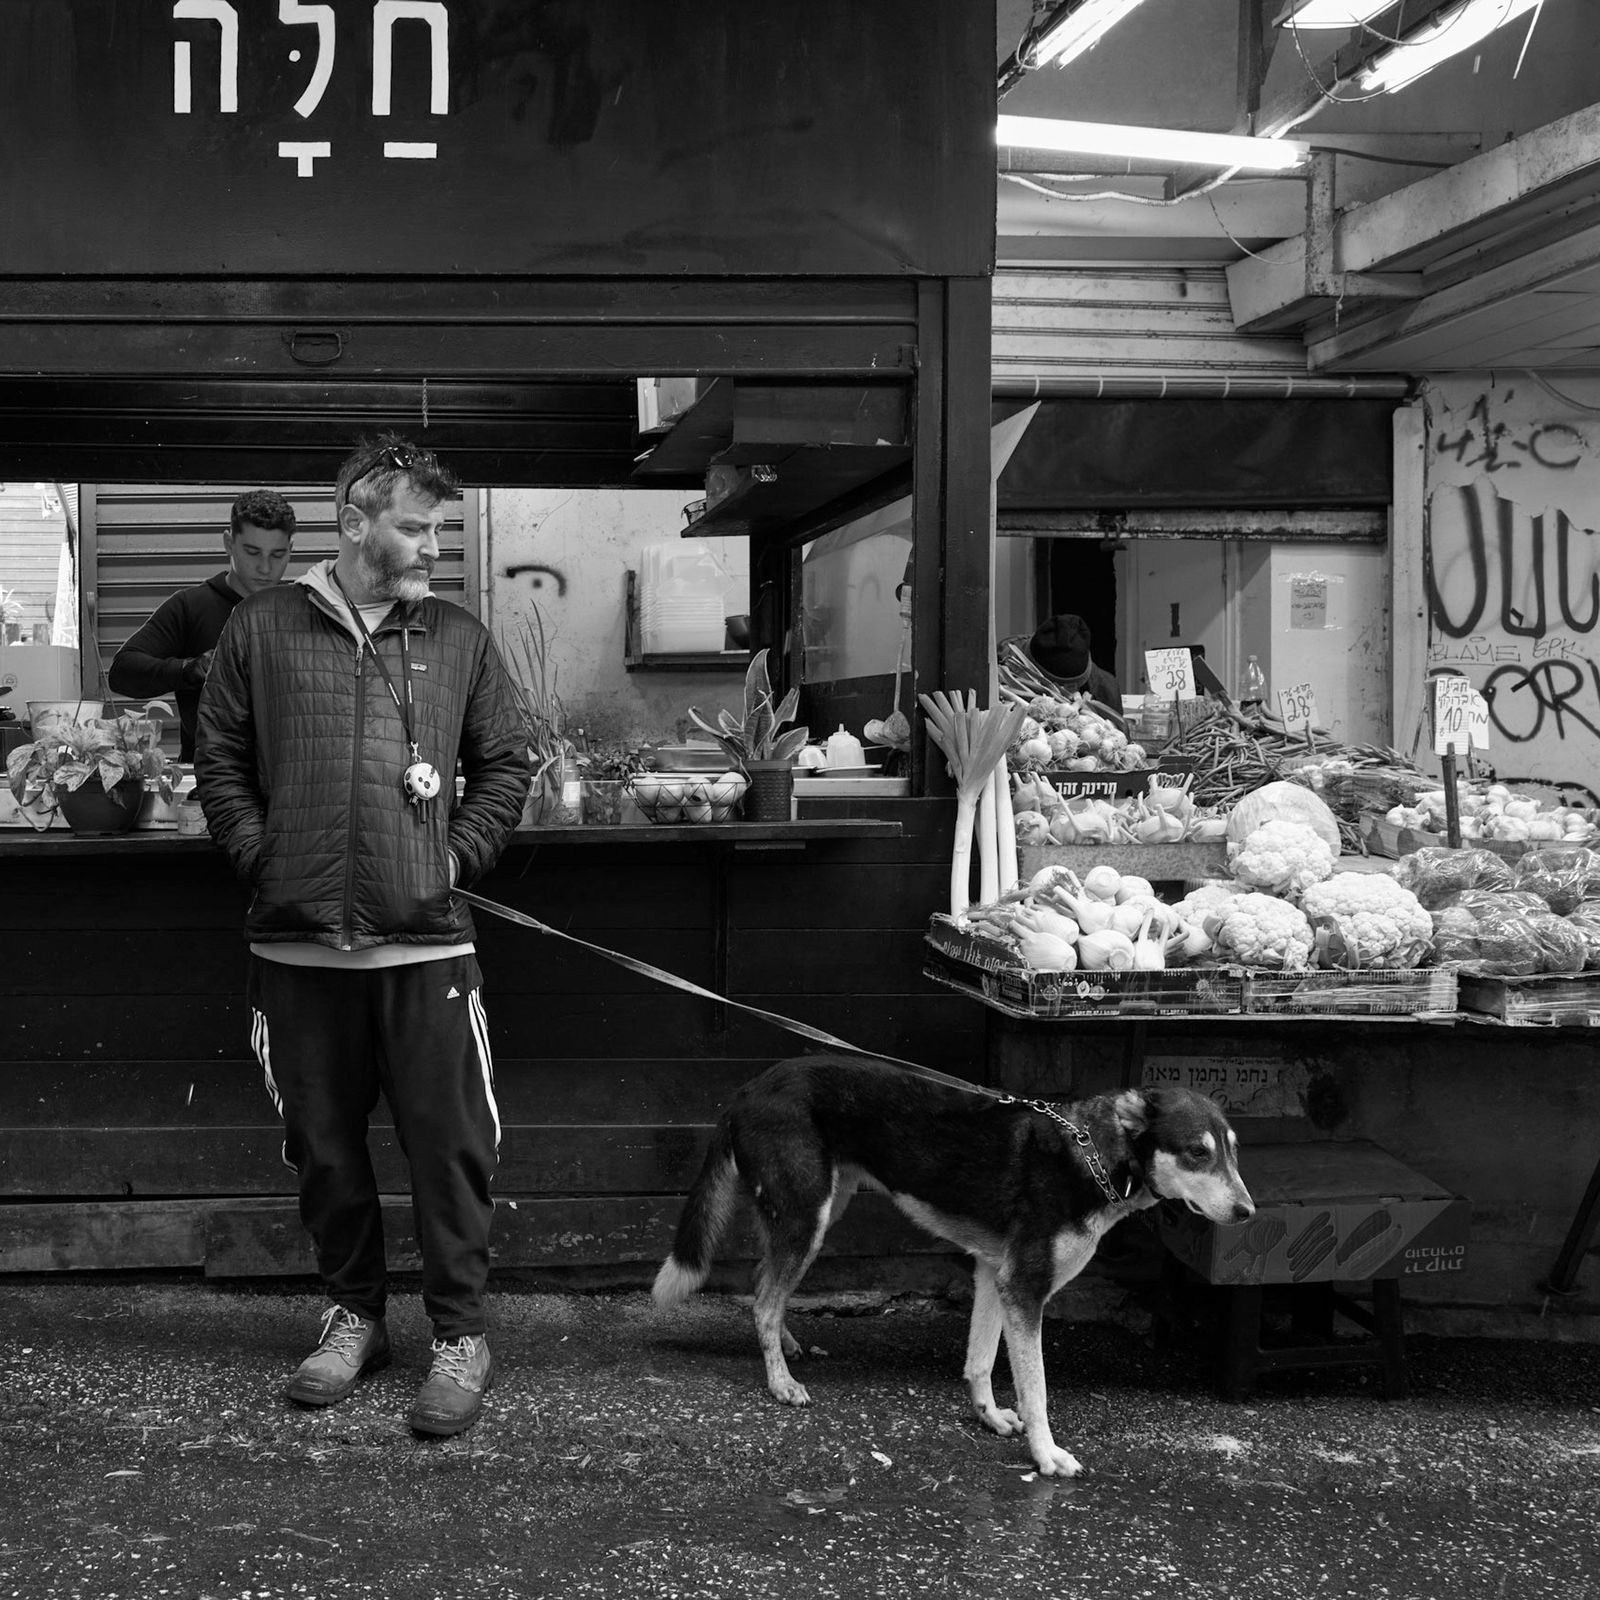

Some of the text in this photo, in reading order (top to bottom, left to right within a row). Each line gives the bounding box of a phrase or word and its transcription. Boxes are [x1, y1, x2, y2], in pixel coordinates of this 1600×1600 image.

[1165, 669, 1186, 691] 28
[1287, 695, 1311, 722] 28
[1443, 705, 1463, 734] 10
[1055, 781, 1118, 795] מרינה זהב
[1404, 1256, 1463, 1274] ירקות
